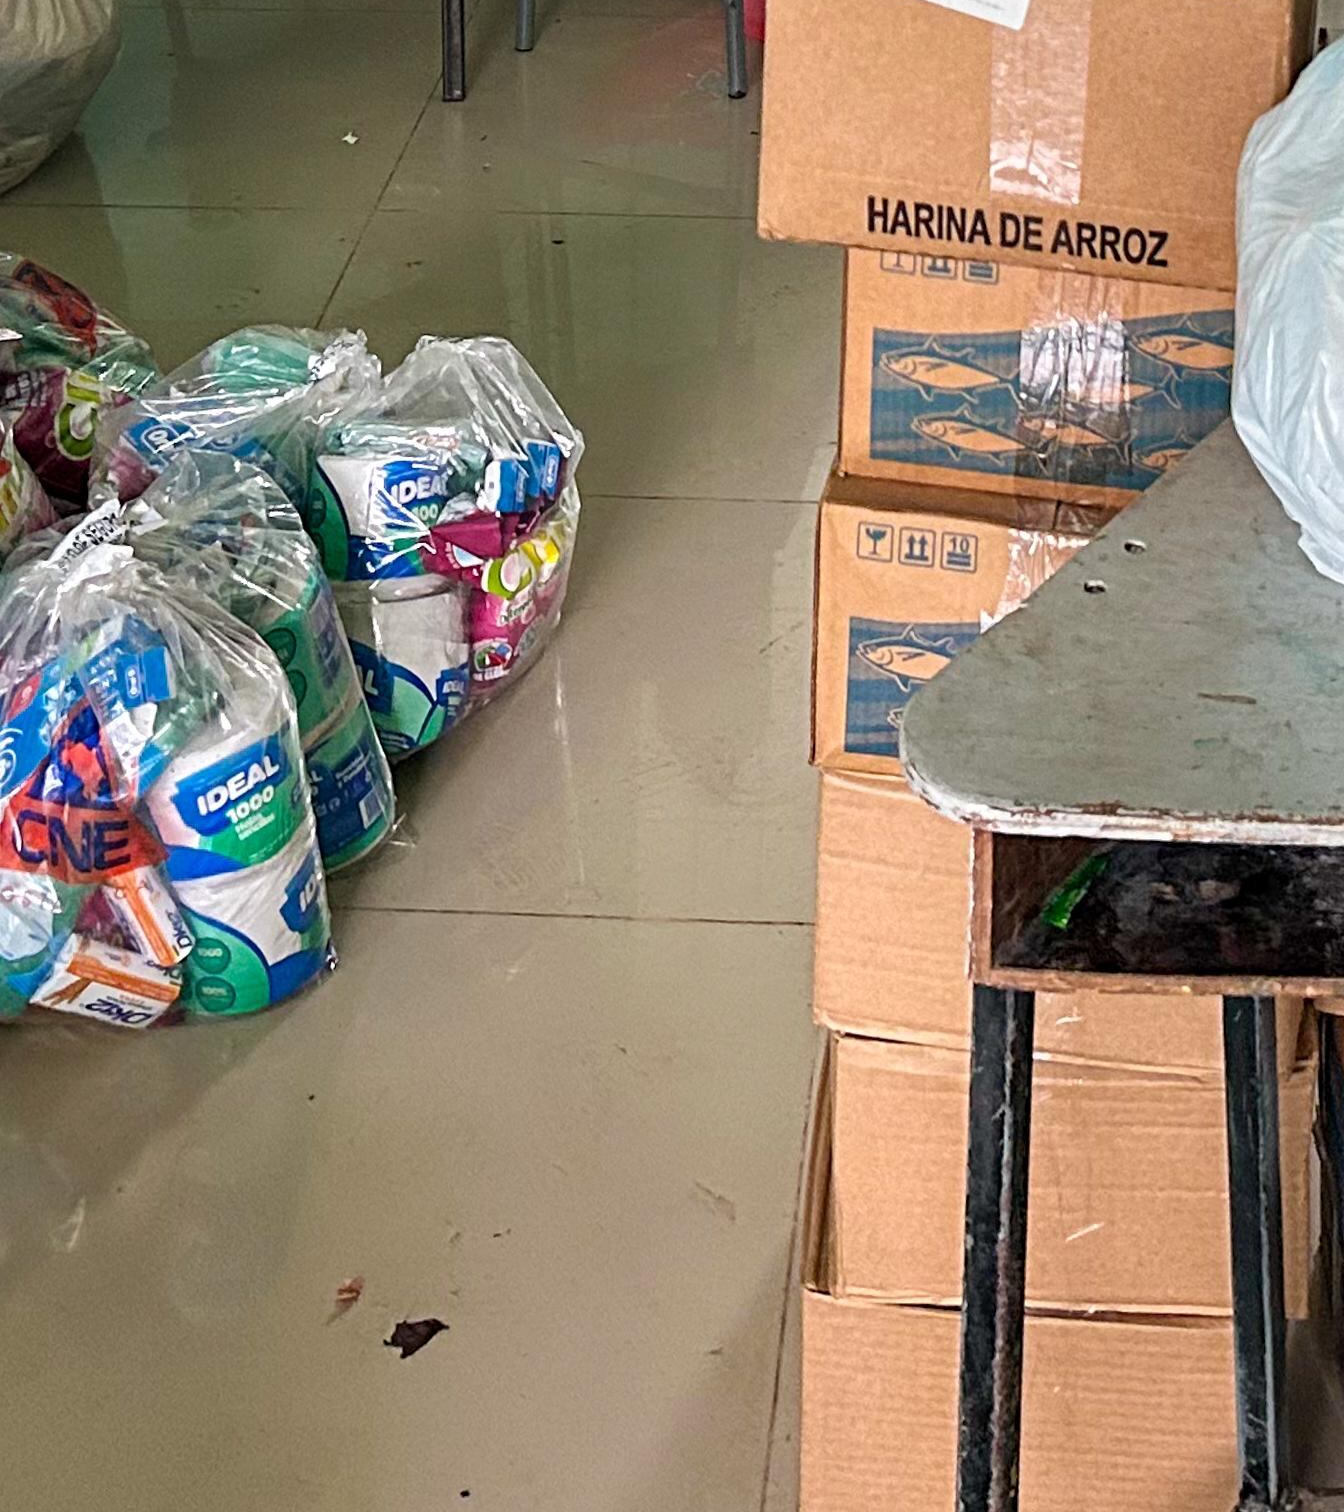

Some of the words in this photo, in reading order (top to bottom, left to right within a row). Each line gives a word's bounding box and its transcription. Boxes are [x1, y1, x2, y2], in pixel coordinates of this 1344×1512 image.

[865, 195, 989, 248] HARINA
[999, 210, 1044, 252] DE
[1053, 220, 1170, 268] ARROZ
[196, 754, 281, 817] IDEAL
[225, 783, 276, 825] 1000
[11, 808, 133, 875] CNE
